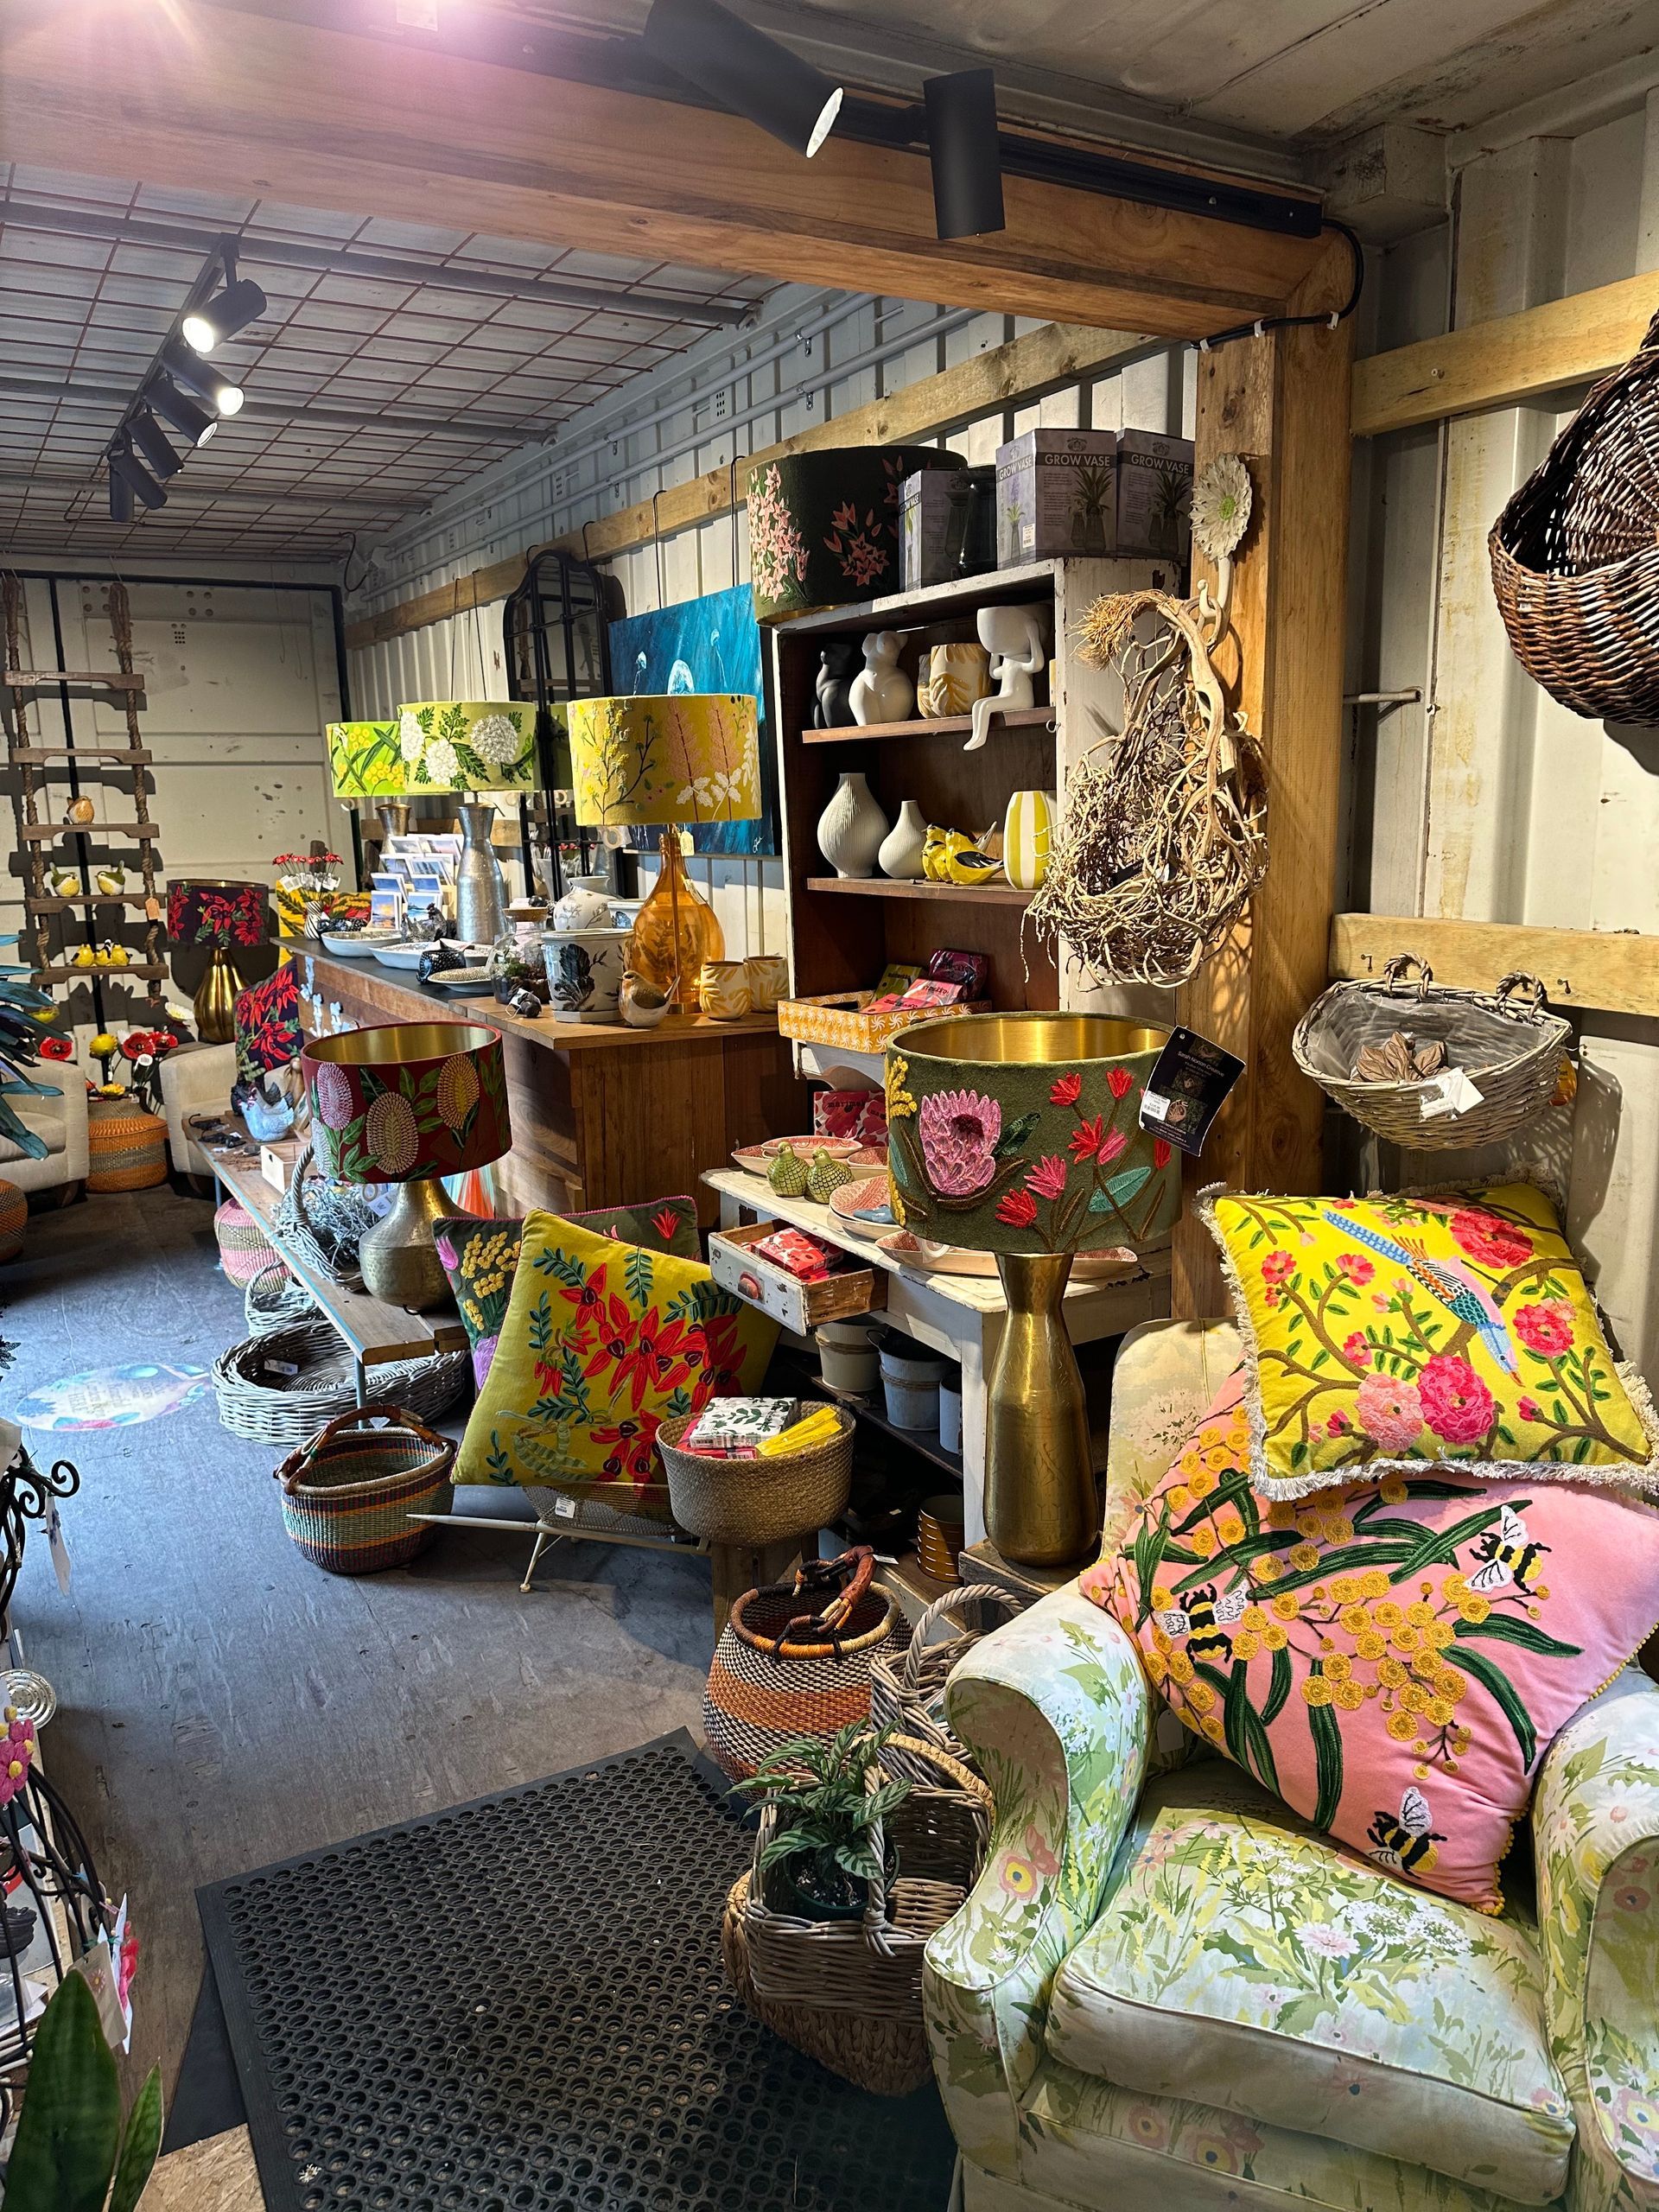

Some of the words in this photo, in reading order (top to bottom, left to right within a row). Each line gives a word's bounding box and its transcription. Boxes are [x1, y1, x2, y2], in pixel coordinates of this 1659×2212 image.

[999, 462, 1017, 480] GROW
[1017, 455, 1033, 473] VASE
[1045, 454, 1083, 466] GROW
[1083, 455, 1110, 467] VASE
[1131, 454, 1163, 467] GROW
[1163, 461, 1190, 474] VASE
